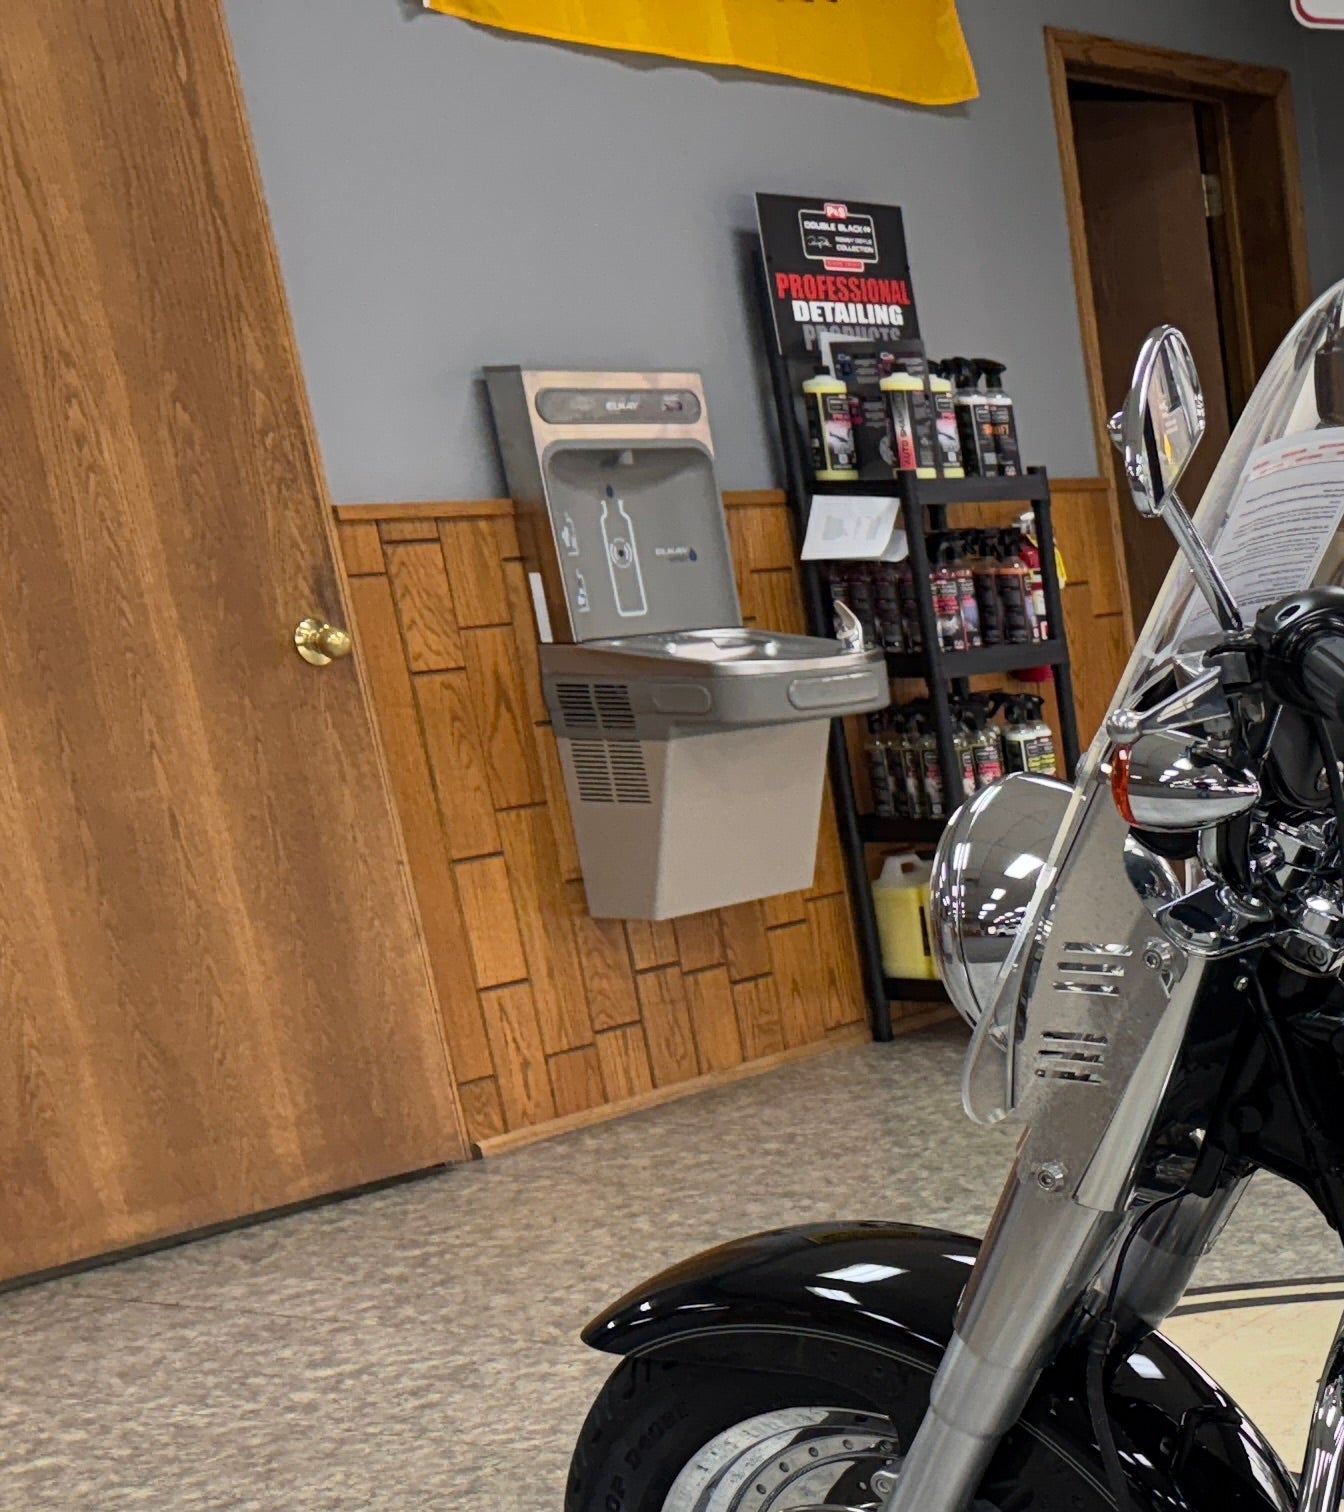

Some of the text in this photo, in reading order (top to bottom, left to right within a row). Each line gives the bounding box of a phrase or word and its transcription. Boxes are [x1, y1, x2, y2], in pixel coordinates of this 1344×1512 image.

[803, 219, 864, 234] DOUBLE BLACK
[775, 272, 911, 305] PROFESSIONAL
[791, 299, 904, 326] DETAILING
